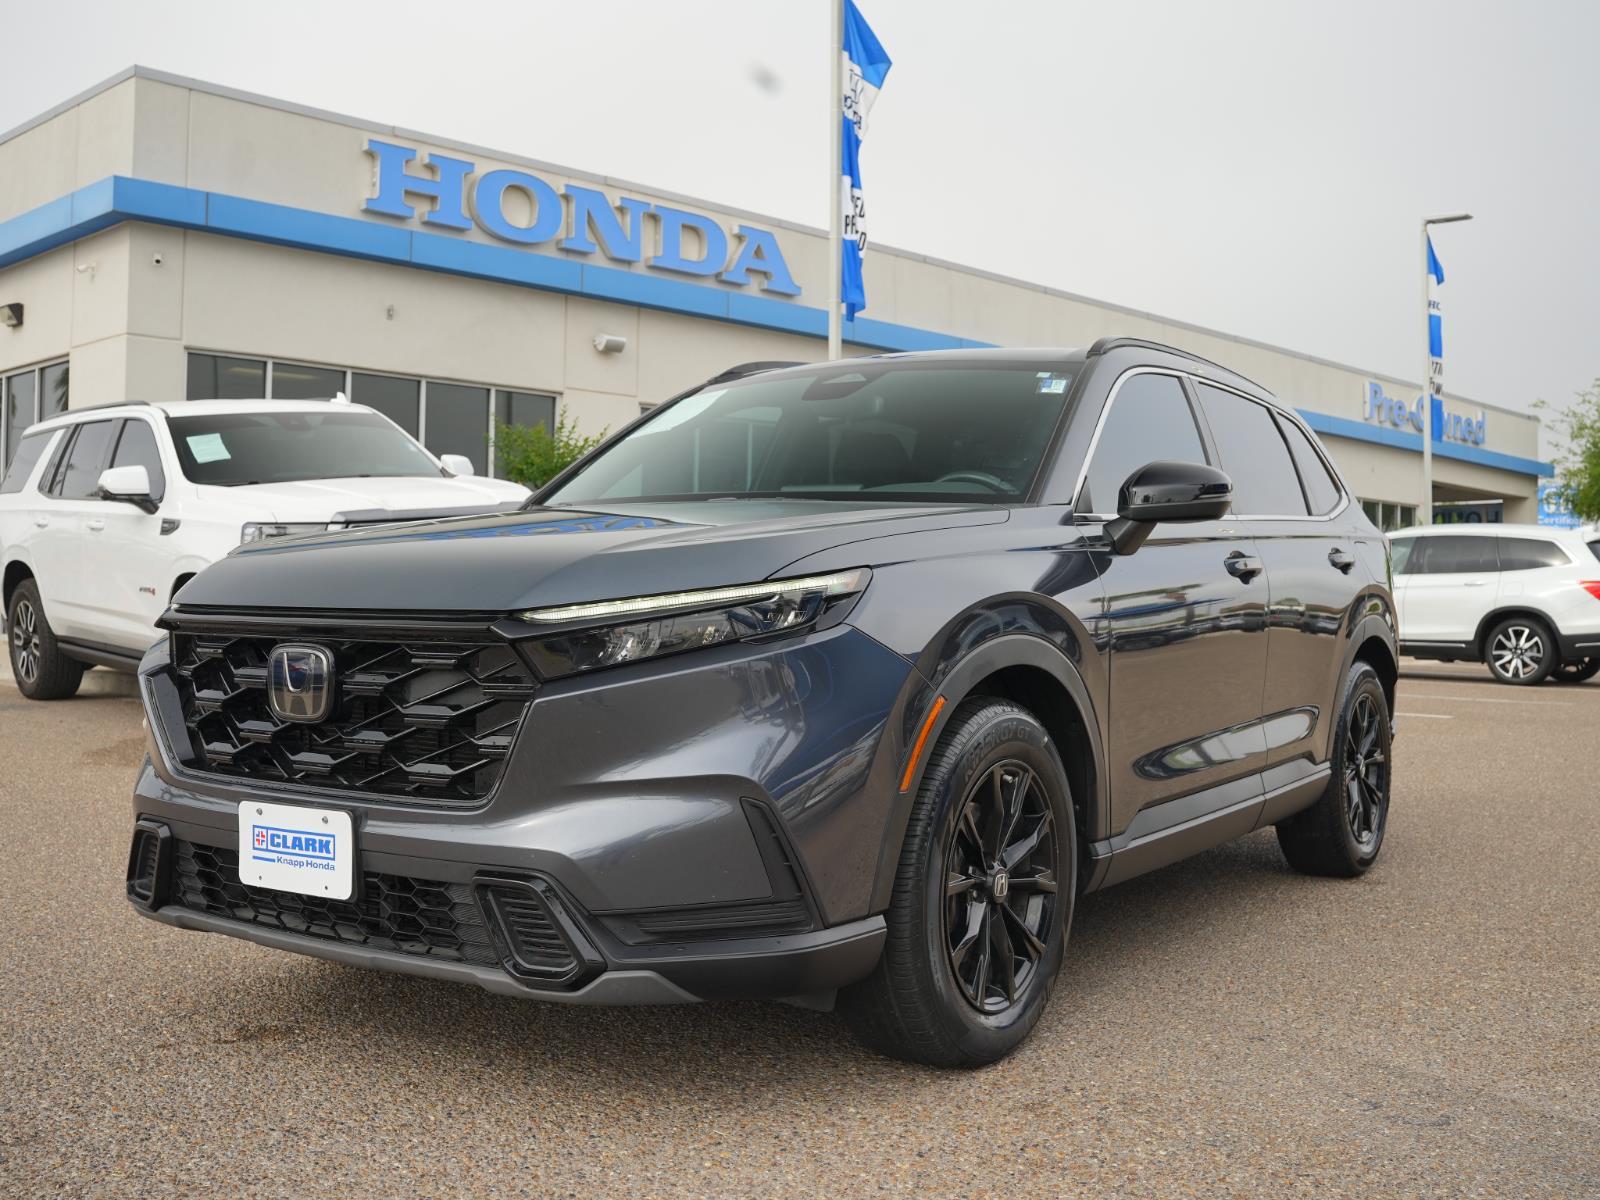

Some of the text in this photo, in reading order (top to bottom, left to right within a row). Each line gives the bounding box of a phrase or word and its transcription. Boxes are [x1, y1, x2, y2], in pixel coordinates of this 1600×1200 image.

[362, 139, 801, 297] HONDA
[269, 833, 331, 854] CLARK
[276, 855, 335, 871] Knapp Honda
